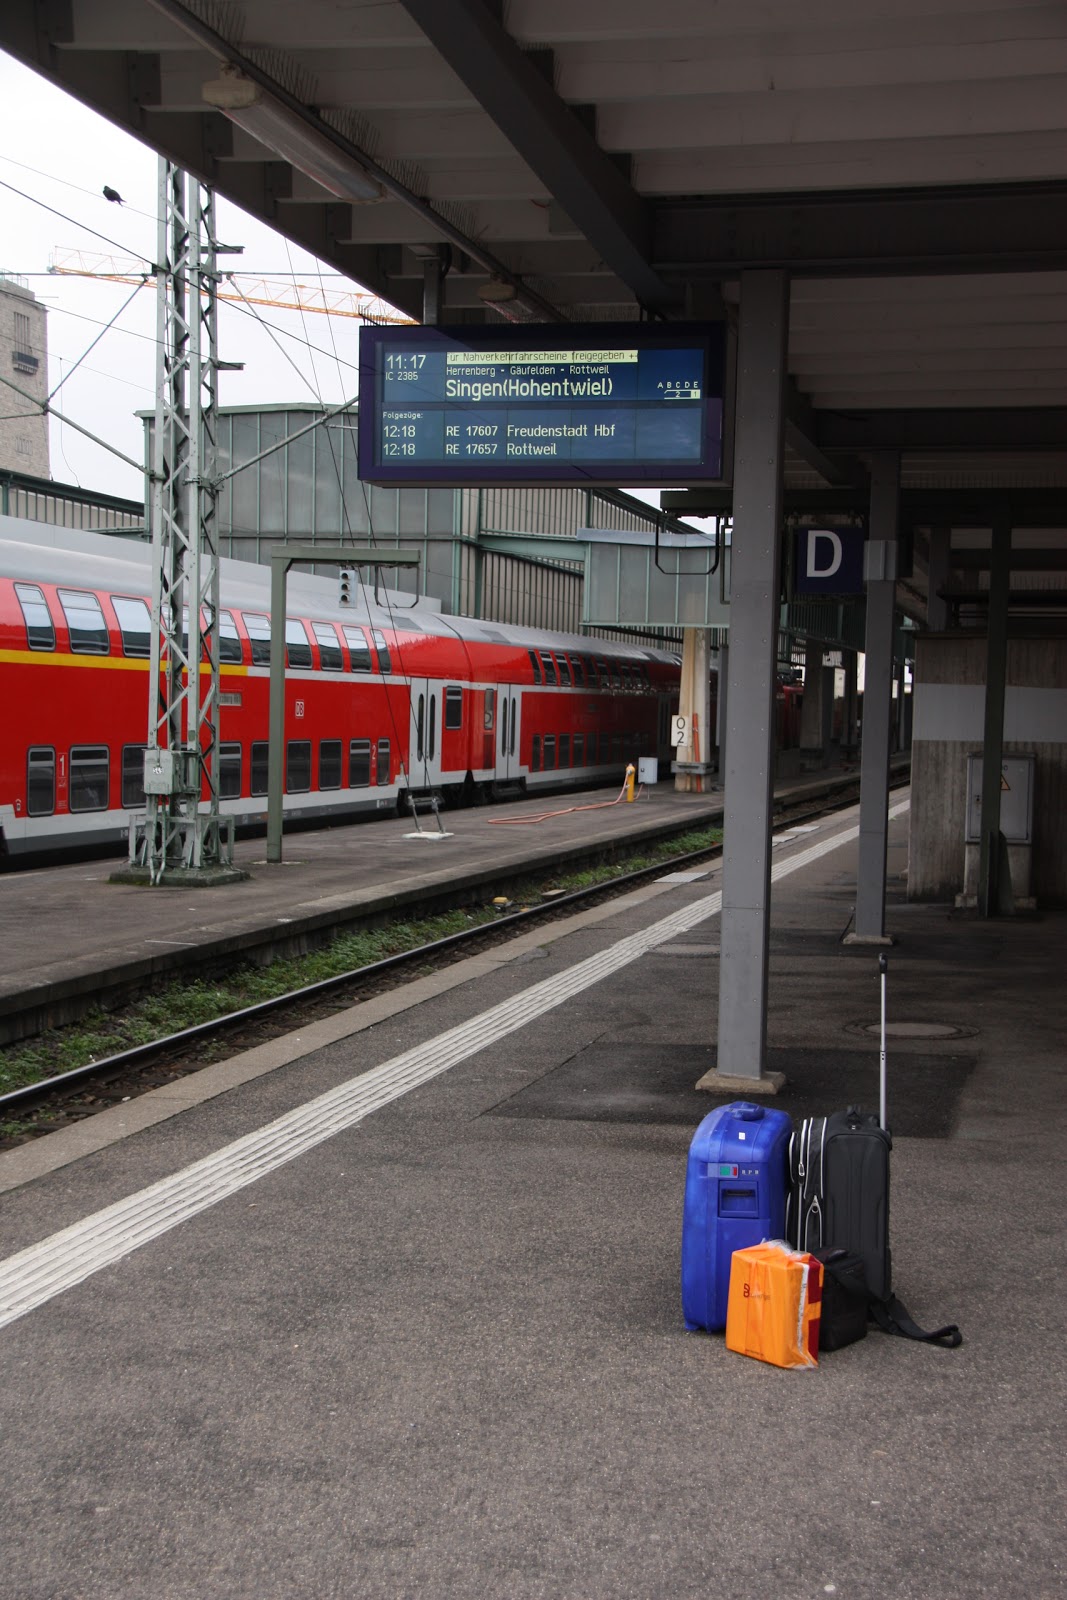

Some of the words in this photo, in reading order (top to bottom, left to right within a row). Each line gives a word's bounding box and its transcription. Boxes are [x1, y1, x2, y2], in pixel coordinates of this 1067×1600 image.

[386, 354, 426, 369] 11:17
[463, 352, 568, 362] Nahverkehrfahrscheine
[572, 351, 625, 362] freigegeben
[385, 371, 394, 381] IC
[397, 371, 419, 381] 2385
[446, 366, 496, 377] Herrenberg
[510, 365, 556, 375] Gäufelden
[569, 365, 610, 375] Rottweil
[446, 378, 613, 401] Singen(Hohentwiel)
[657, 381, 664, 389] A
[667, 381, 672, 389] B
[675, 381, 681, 389] C
[684, 381, 690, 389] D
[693, 381, 699, 389] E
[675, 390, 681, 398] 2
[382, 411, 423, 420] Folgezüge:
[383, 425, 416, 438] 12:18
[446, 426, 460, 437] RE
[466, 425, 498, 437] 17607
[507, 424, 588, 437] Freudenstadt
[594, 424, 616, 437] Hbf
[383, 443, 416, 456] 12:18
[446, 444, 460, 455] RE
[465, 443, 498, 455] 17657
[506, 443, 557, 456] Rottweil
[806, 529, 843, 578] D
[296, 701, 304, 716] DB
[676, 731, 685, 744] 2
[371, 744, 377, 760] 2
[59, 754, 65, 777] 1
